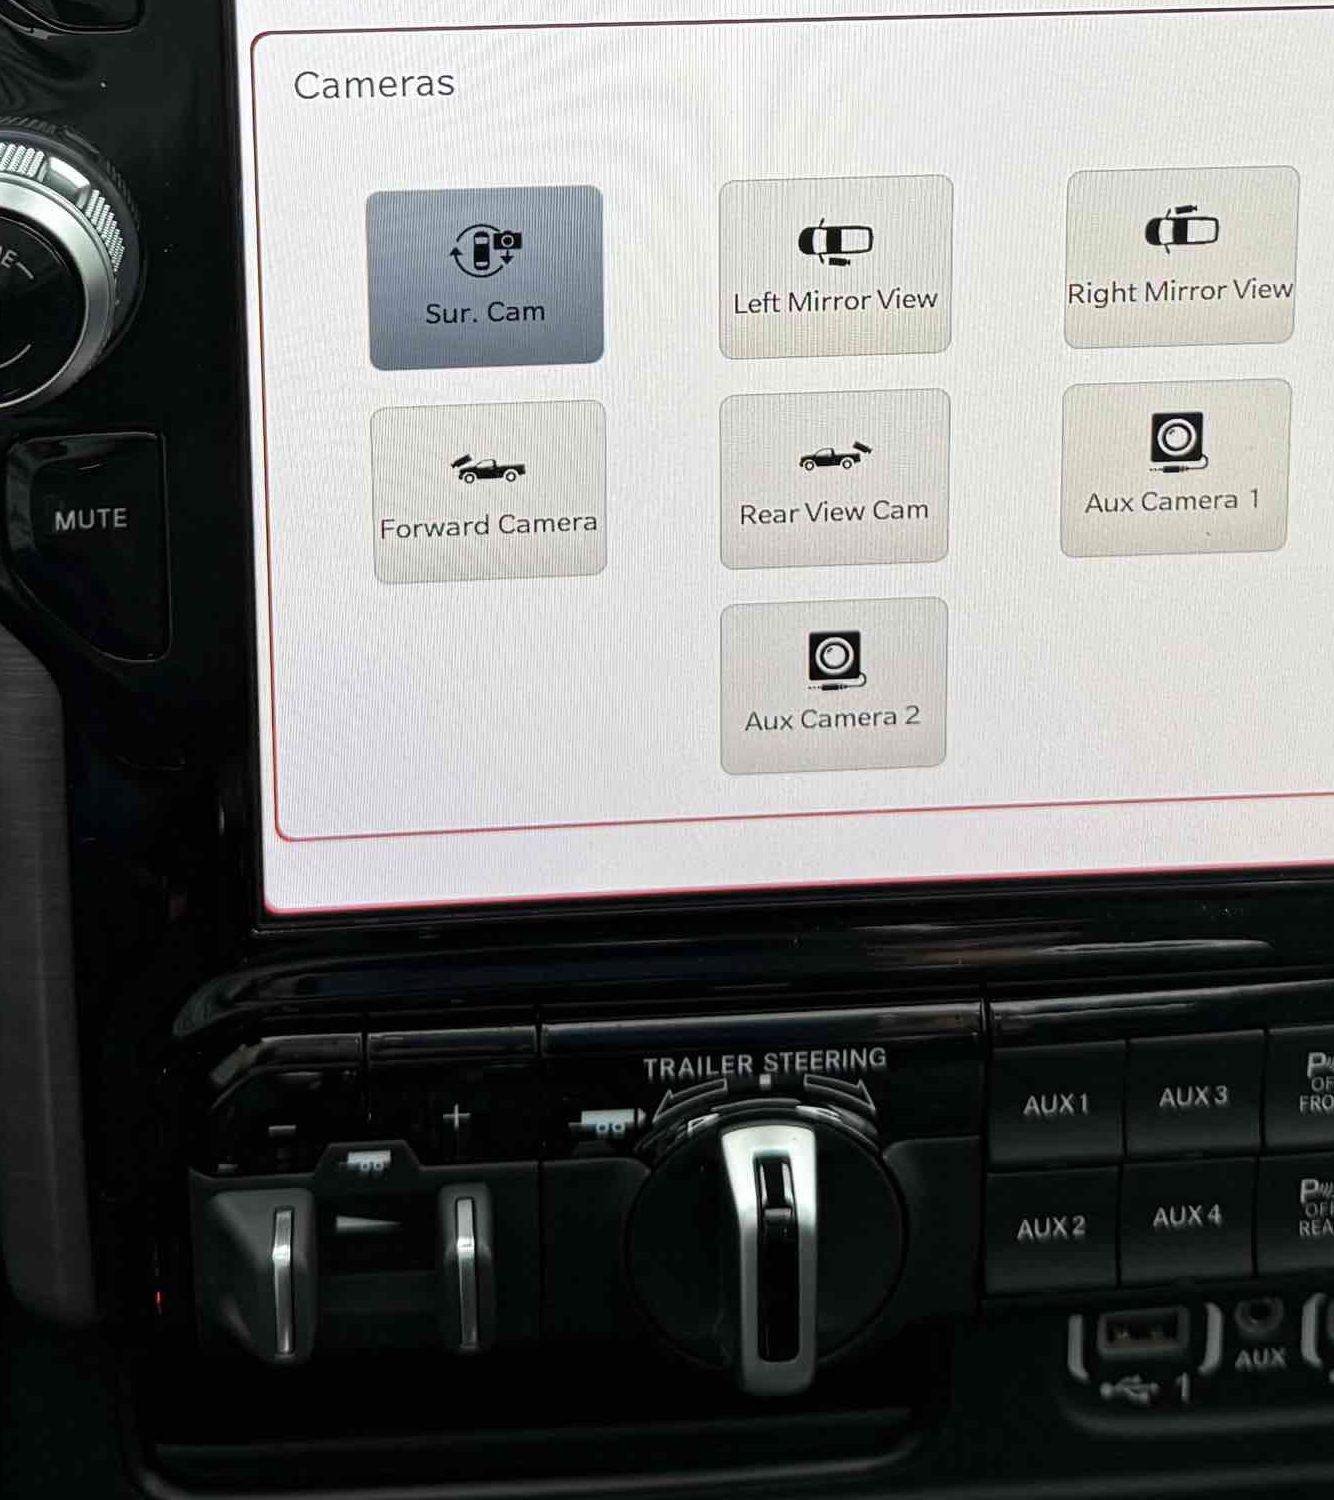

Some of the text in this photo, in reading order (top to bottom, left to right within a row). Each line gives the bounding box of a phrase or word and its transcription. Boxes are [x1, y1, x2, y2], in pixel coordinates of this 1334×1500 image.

[293, 66, 455, 101] Cameras
[733, 286, 939, 314] Left Mirror View
[1067, 277, 1294, 311] Right Mirror View
[425, 299, 546, 325] Sur. Cam
[740, 500, 929, 526] Rear View Cam
[1084, 488, 1260, 515] Aux Camera 1
[55, 508, 128, 532] MUTE
[379, 512, 599, 539] Forward Camera
[744, 705, 921, 732] Aux Camera 2
[644, 1047, 887, 1079] TRAILER STEERING
[1023, 1094, 1089, 1115] AUX 1
[1159, 1085, 1228, 1108] AUX 3
[1017, 1216, 1086, 1240] AUX 2
[1153, 1205, 1222, 1228] AUX 4
[1235, 1347, 1288, 1369] AUX
[1176, 1373, 1190, 1401] 1
